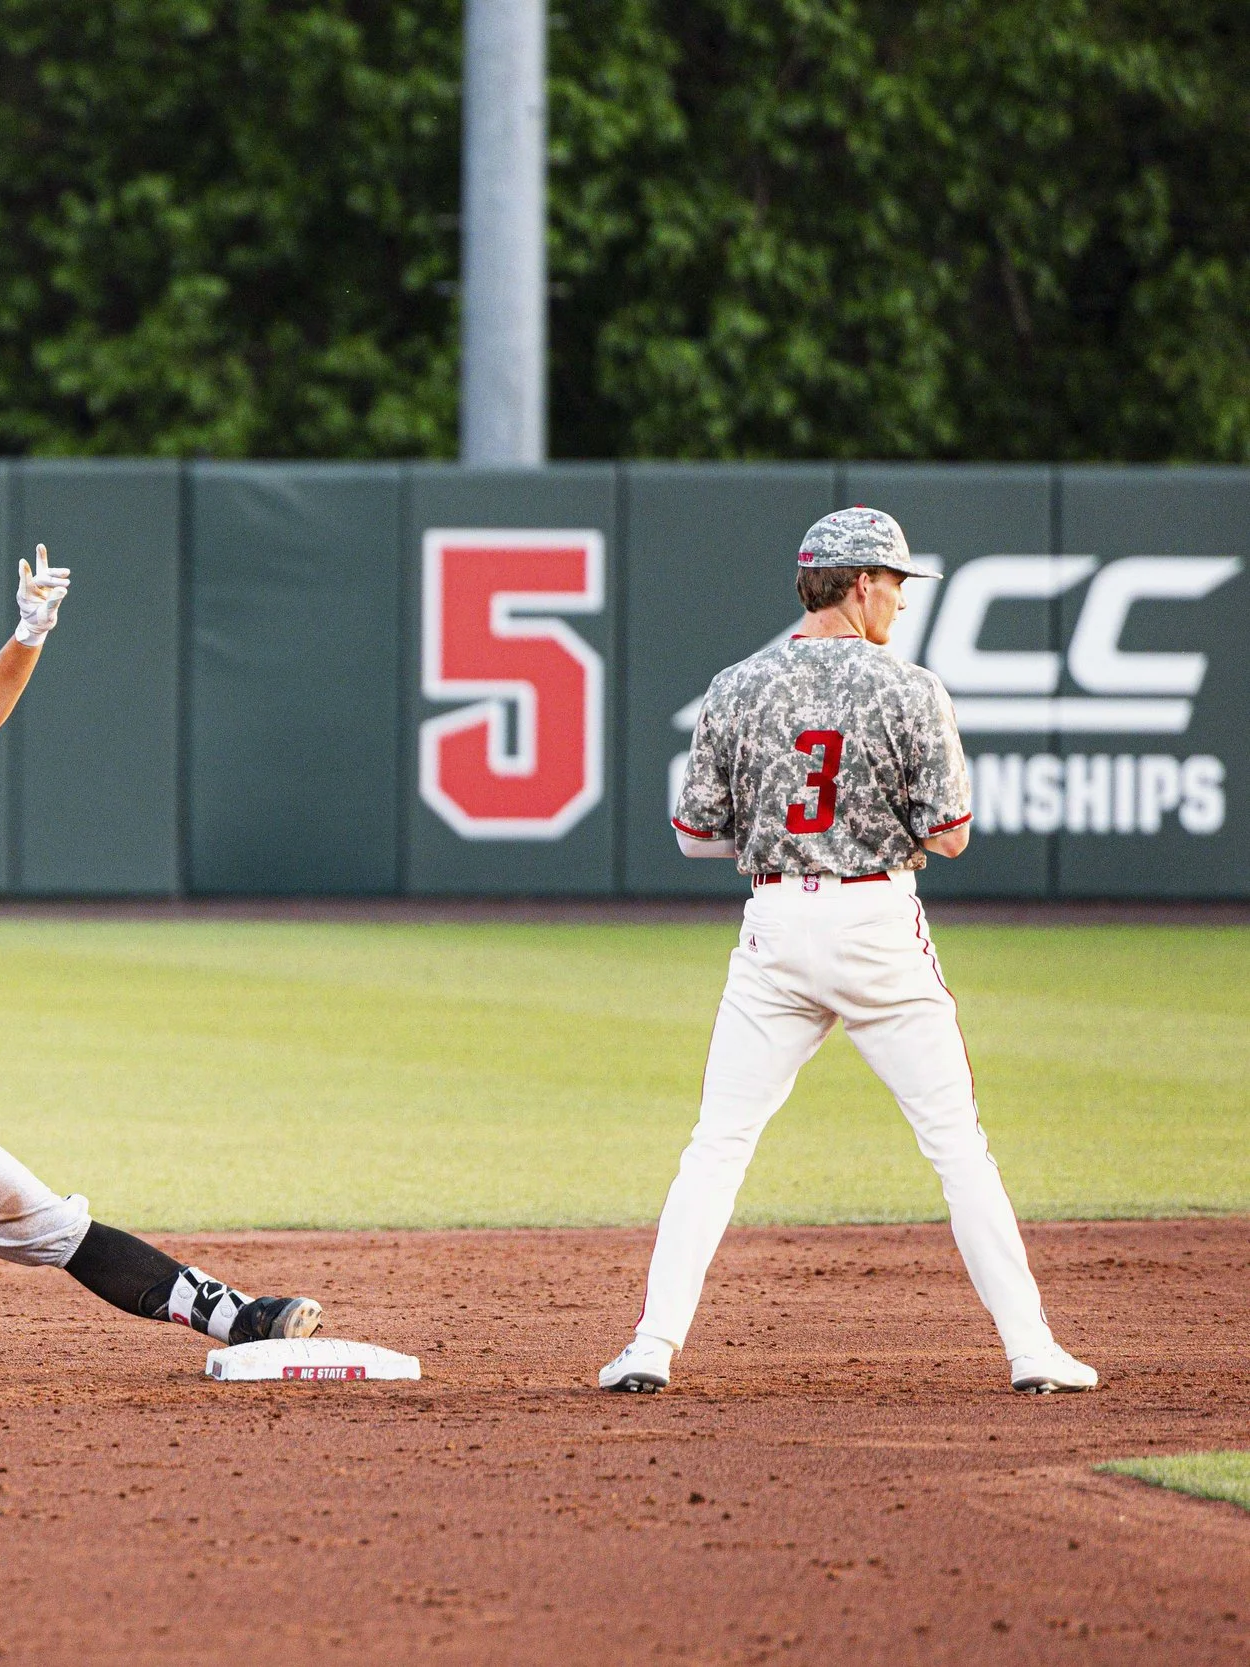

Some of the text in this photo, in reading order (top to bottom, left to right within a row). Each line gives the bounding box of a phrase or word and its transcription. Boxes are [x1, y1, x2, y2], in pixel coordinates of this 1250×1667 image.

[420, 528, 605, 840] 5
[786, 729, 843, 834] 3
[300, 1368, 348, 1379] NC STATE
